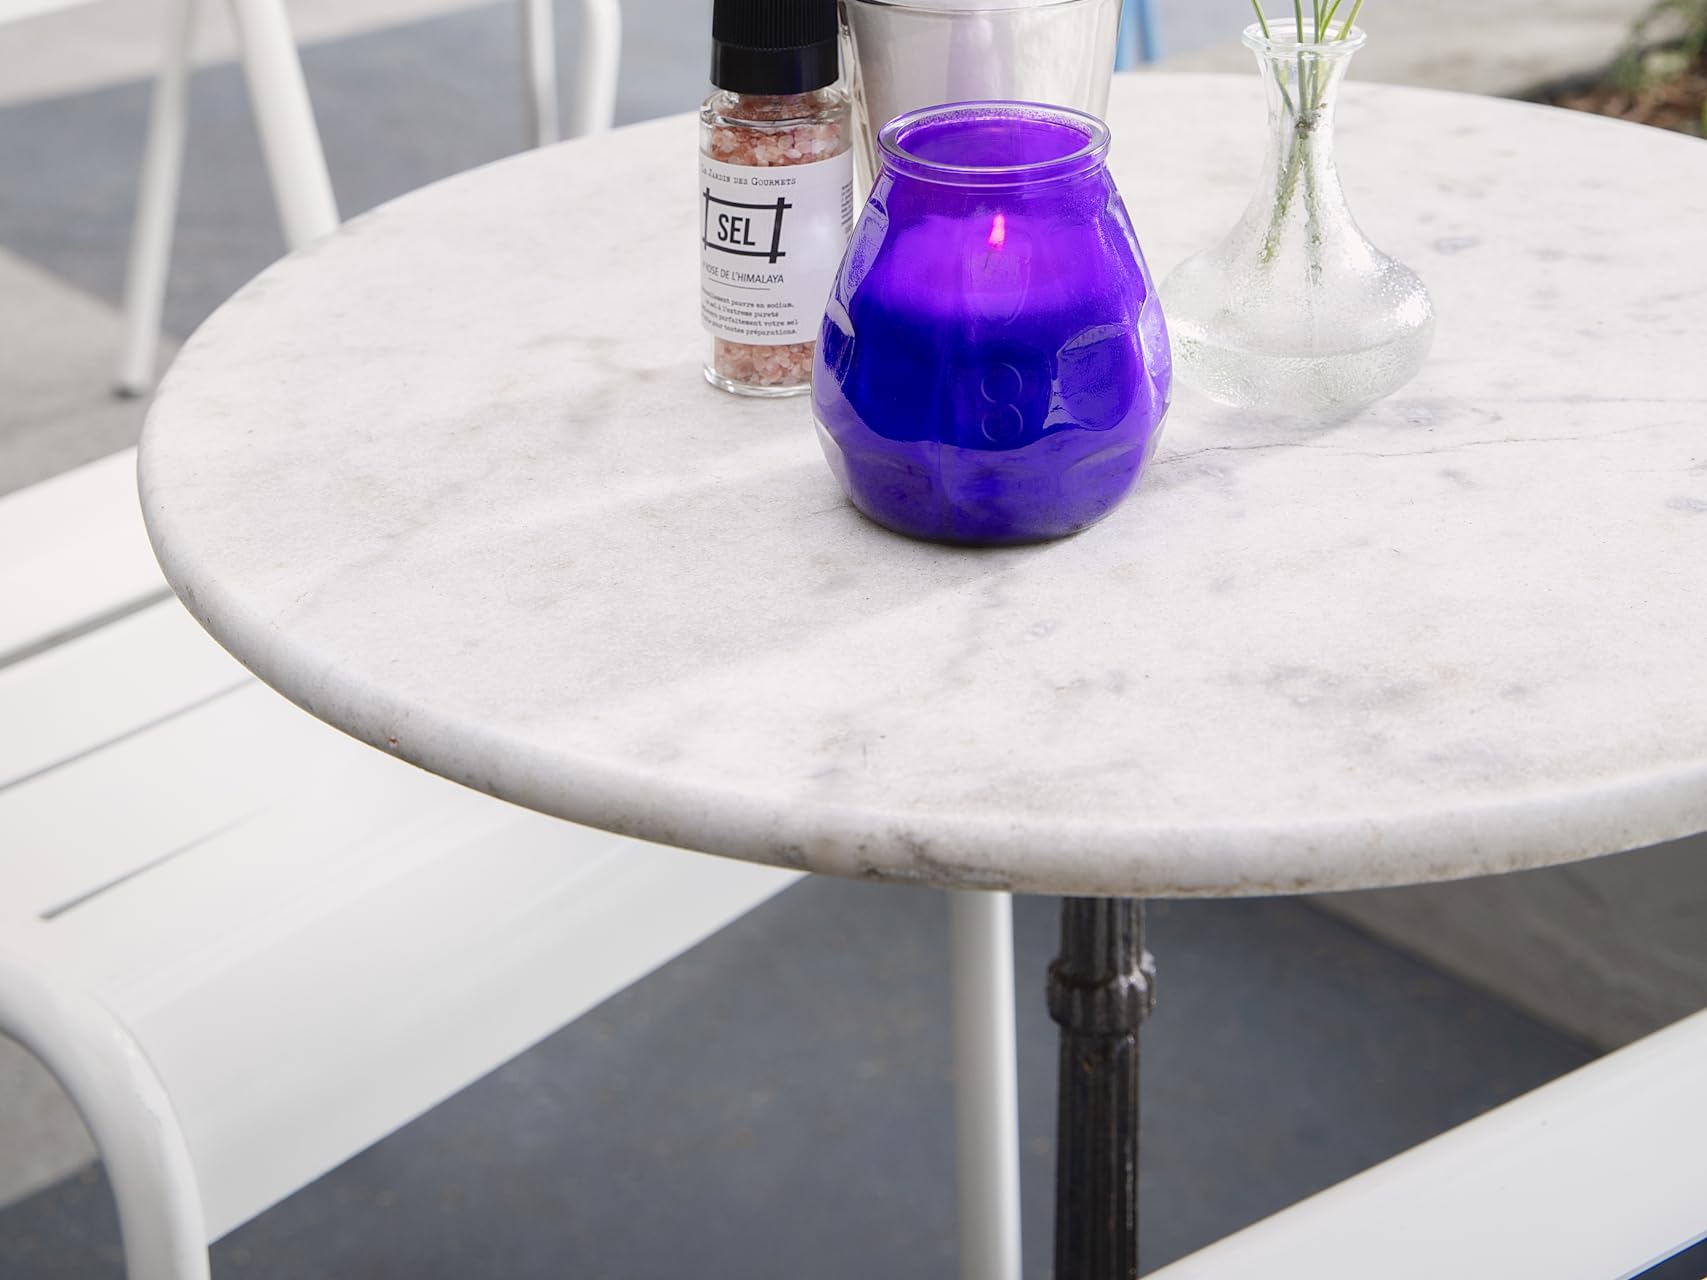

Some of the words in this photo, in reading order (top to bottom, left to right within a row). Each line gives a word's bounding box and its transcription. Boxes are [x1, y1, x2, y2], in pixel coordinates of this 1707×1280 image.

[751, 177, 796, 186] GOURMETS
[717, 213, 756, 246] SEL
[720, 268, 730, 280] DE
[732, 271, 784, 283] L'HIMALAYA
